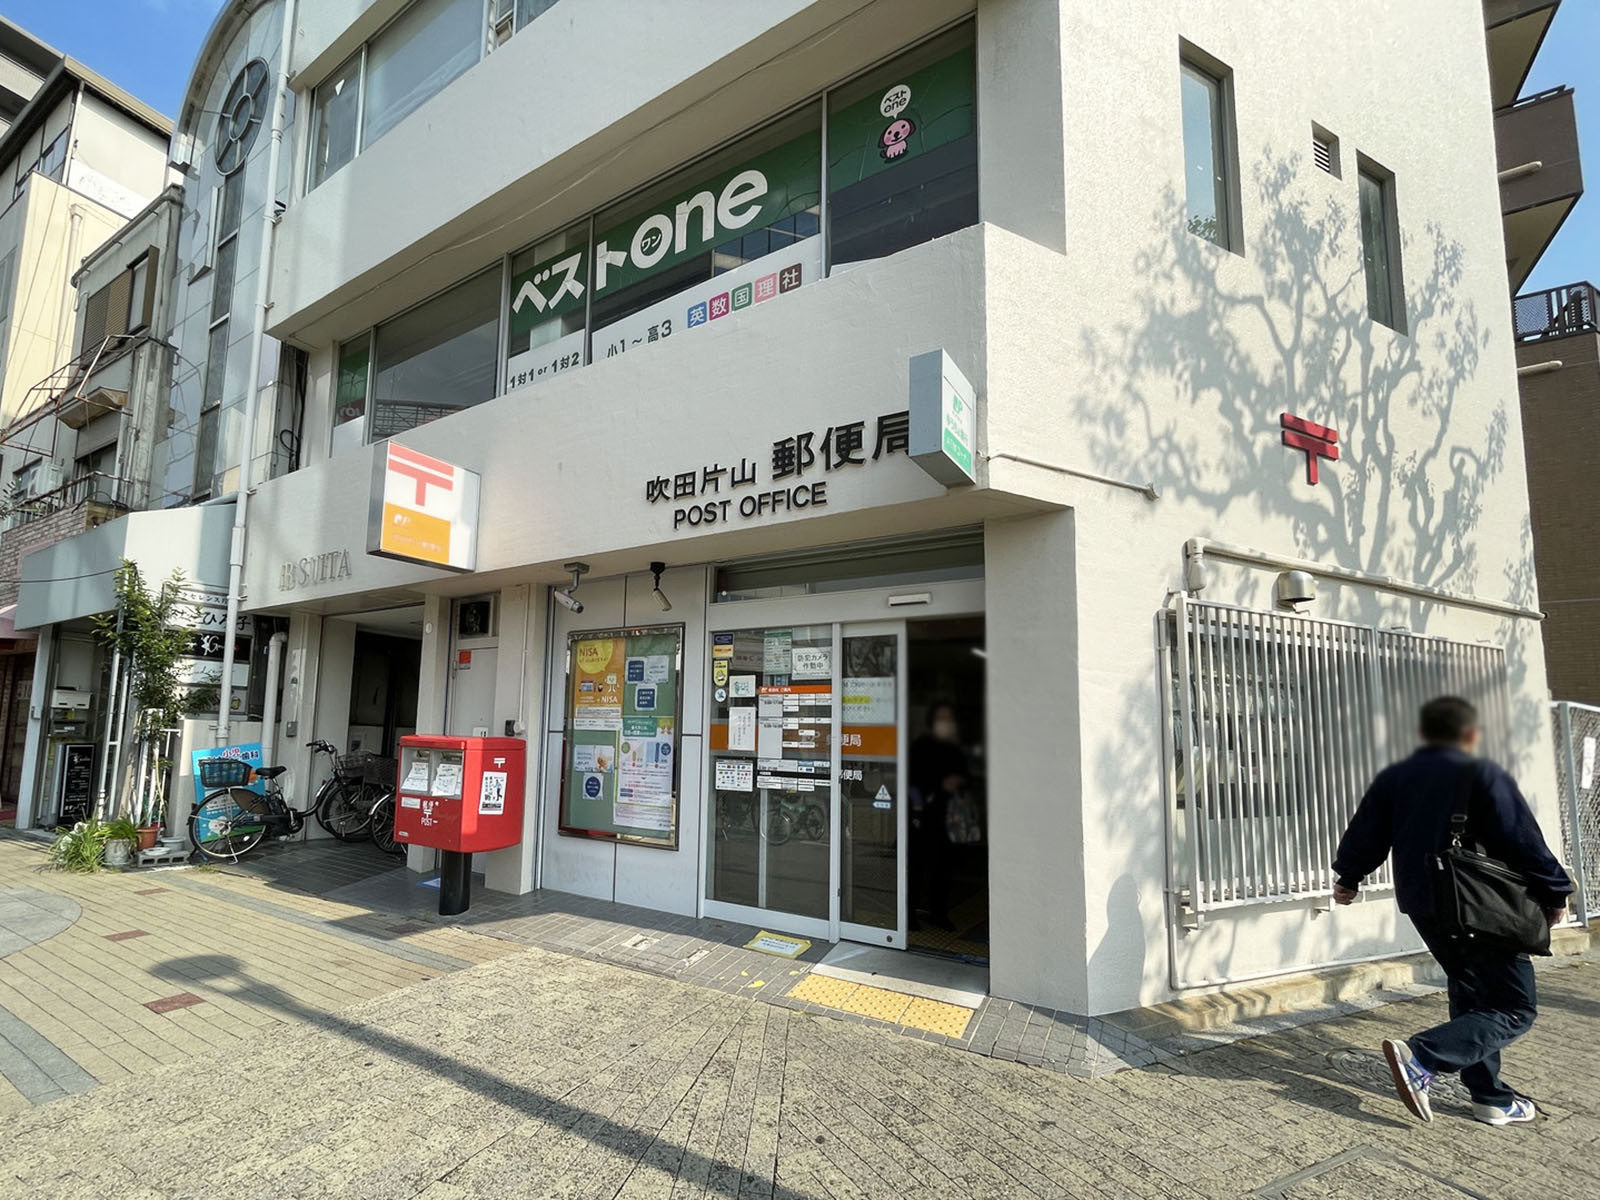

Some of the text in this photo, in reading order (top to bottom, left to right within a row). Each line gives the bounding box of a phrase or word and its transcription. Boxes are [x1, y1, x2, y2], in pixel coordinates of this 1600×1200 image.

[884, 97, 907, 113] one
[641, 233, 662, 252] ワン
[537, 366, 548, 376] or
[674, 481, 828, 530] POST OFFICE
[579, 647, 598, 656] NISA
